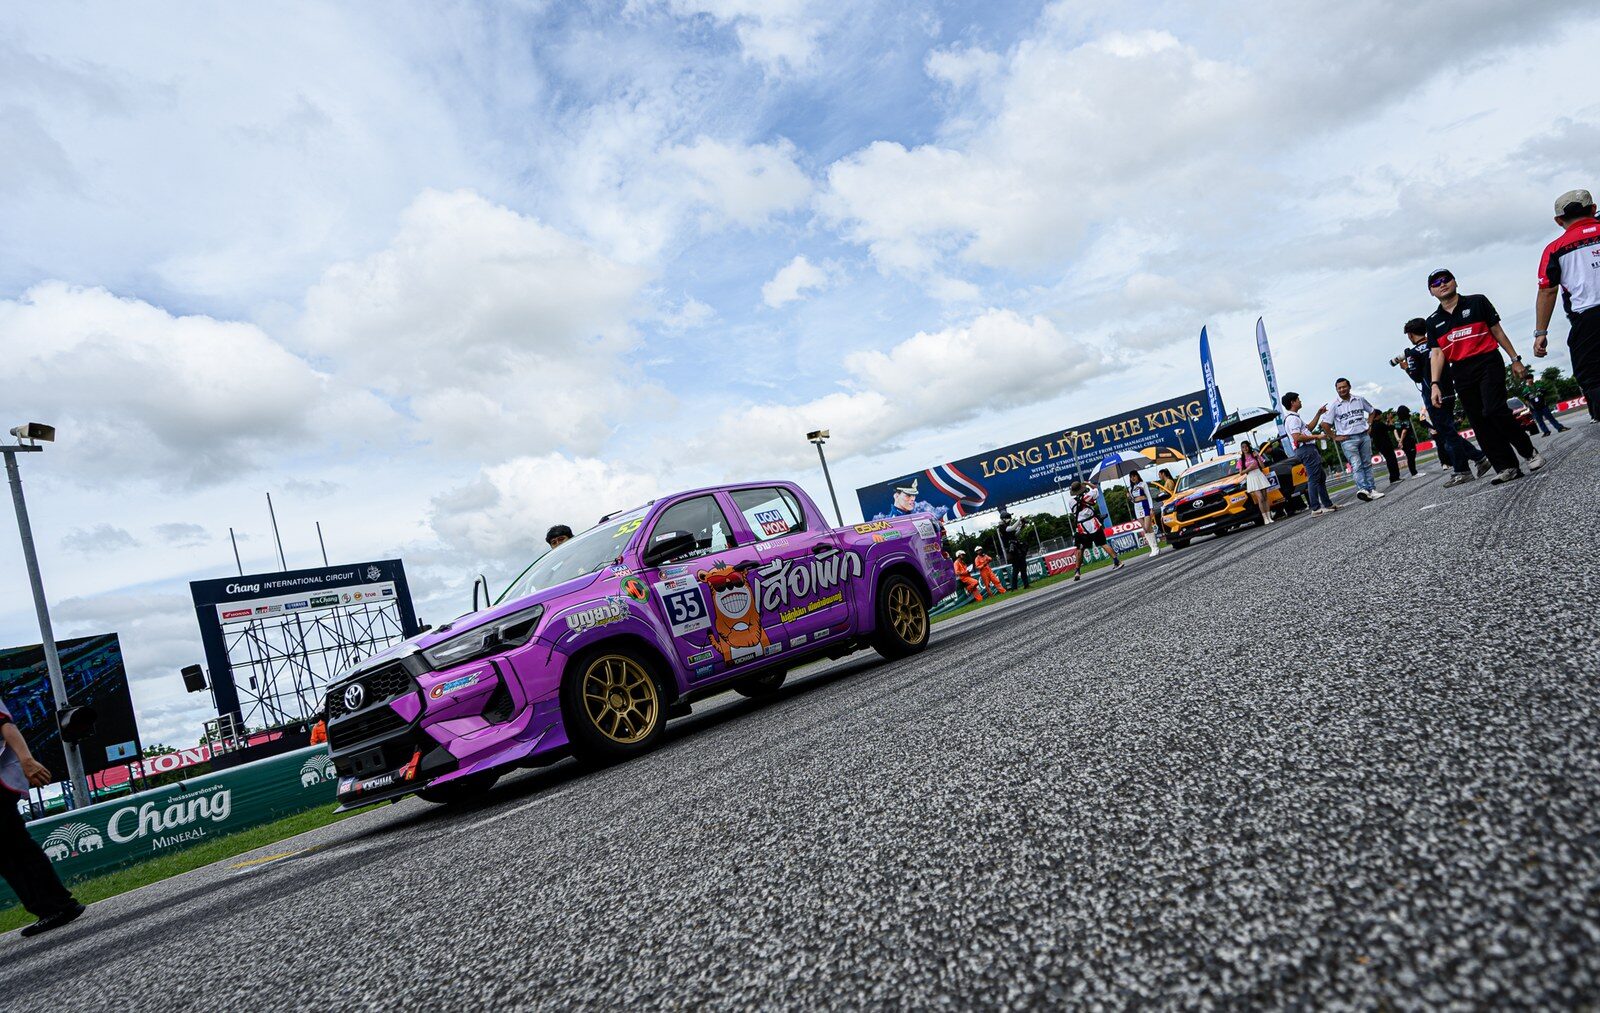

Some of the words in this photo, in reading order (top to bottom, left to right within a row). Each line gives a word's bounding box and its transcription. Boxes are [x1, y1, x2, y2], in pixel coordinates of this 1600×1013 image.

[980, 447, 1042, 478] LONG
[1045, 431, 1095, 459] LIVE
[1096, 418, 1143, 444] THE
[1145, 400, 1203, 431] KING
[1099, 446, 1113, 454] FROM
[1124, 433, 1159, 448] MANAGEMENT
[1144, 437, 1165, 447] CIRCUIT
[1054, 474, 1072, 483] Chang
[756, 511, 781, 523] LIQUI
[763, 521, 788, 535] MOLY
[226, 583, 260, 594] Chang
[264, 577, 323, 589] INTERNATIONAL
[325, 572, 354, 582] CIRCUIT
[671, 591, 700, 622] 55
[107, 788, 232, 843] Chang
[152, 827, 206, 851] MINERAL
